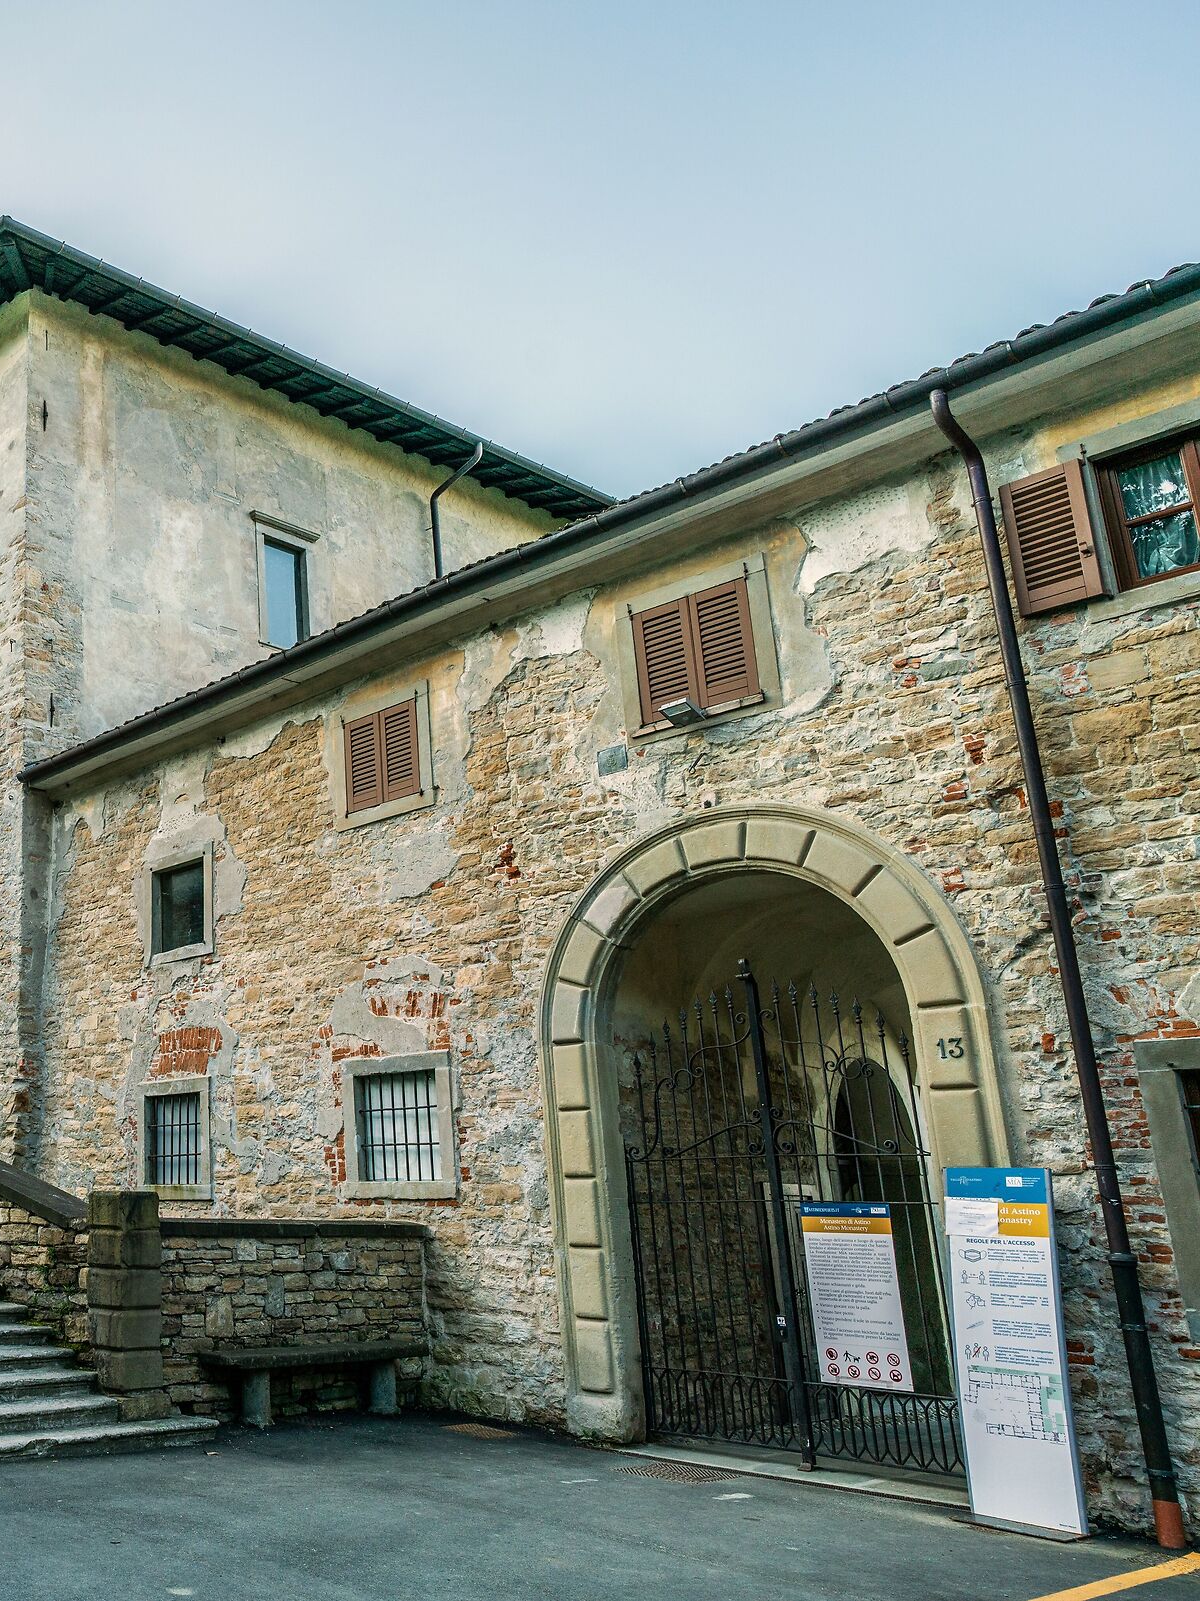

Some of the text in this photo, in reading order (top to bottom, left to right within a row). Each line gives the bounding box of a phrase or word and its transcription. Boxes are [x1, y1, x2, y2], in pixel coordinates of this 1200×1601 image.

[936, 1037, 964, 1059] 13
[1011, 1207, 1041, 1216] Astino
[1000, 1217, 1033, 1226] onastry
